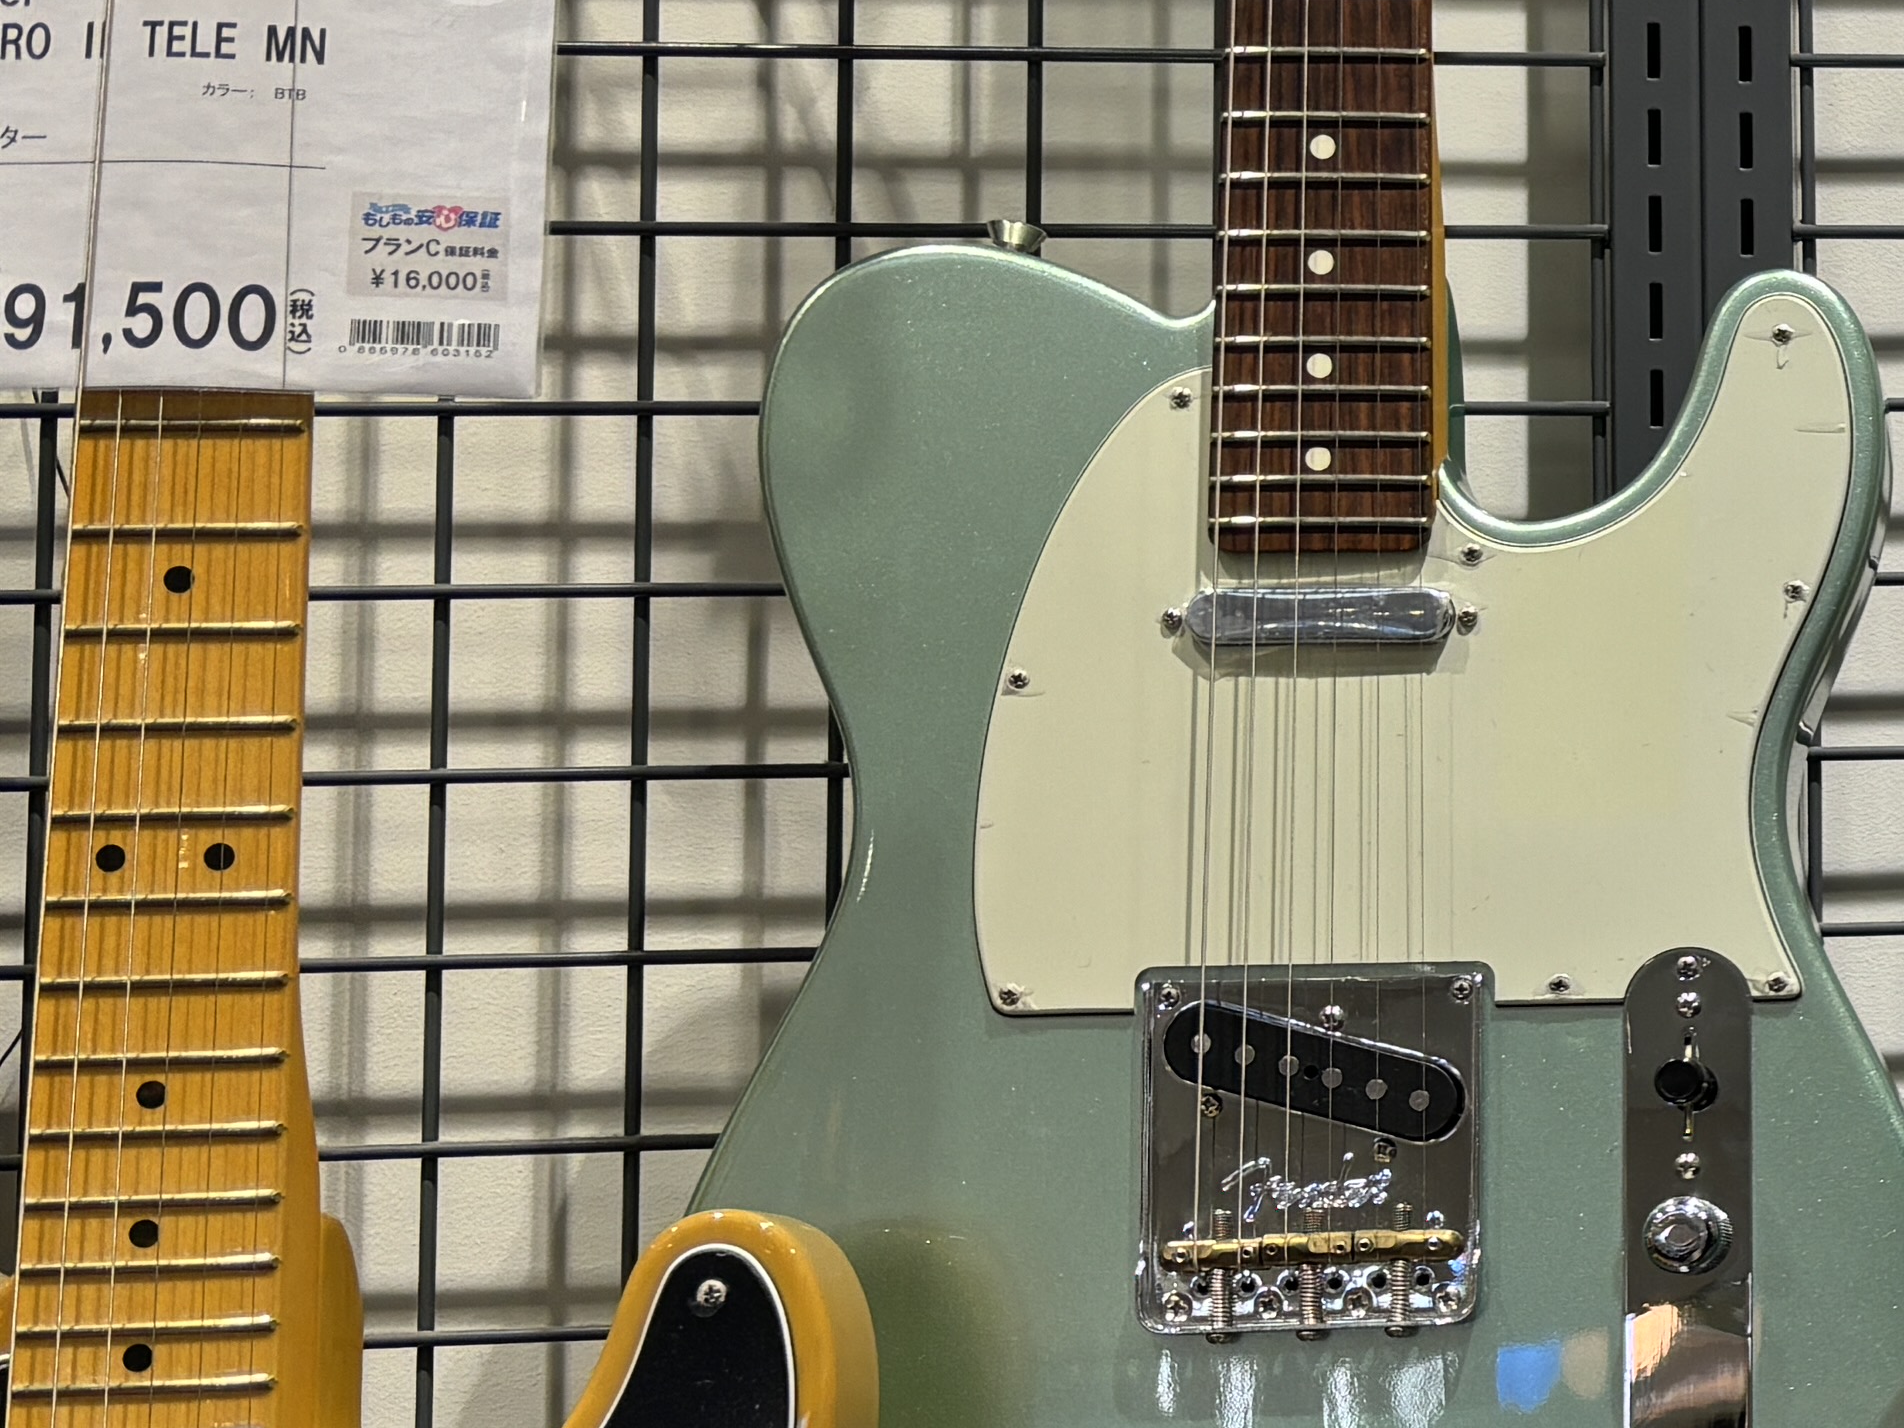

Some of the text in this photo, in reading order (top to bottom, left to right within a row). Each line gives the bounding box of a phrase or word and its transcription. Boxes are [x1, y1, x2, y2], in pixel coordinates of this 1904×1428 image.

[0, 22, 51, 60] RO
[143, 21, 237, 60] TELE
[266, 24, 327, 65] MN
[274, 87, 307, 101] BTB
[371, 268, 477, 291] ¥16,000
[3, 280, 277, 355] 91,500
